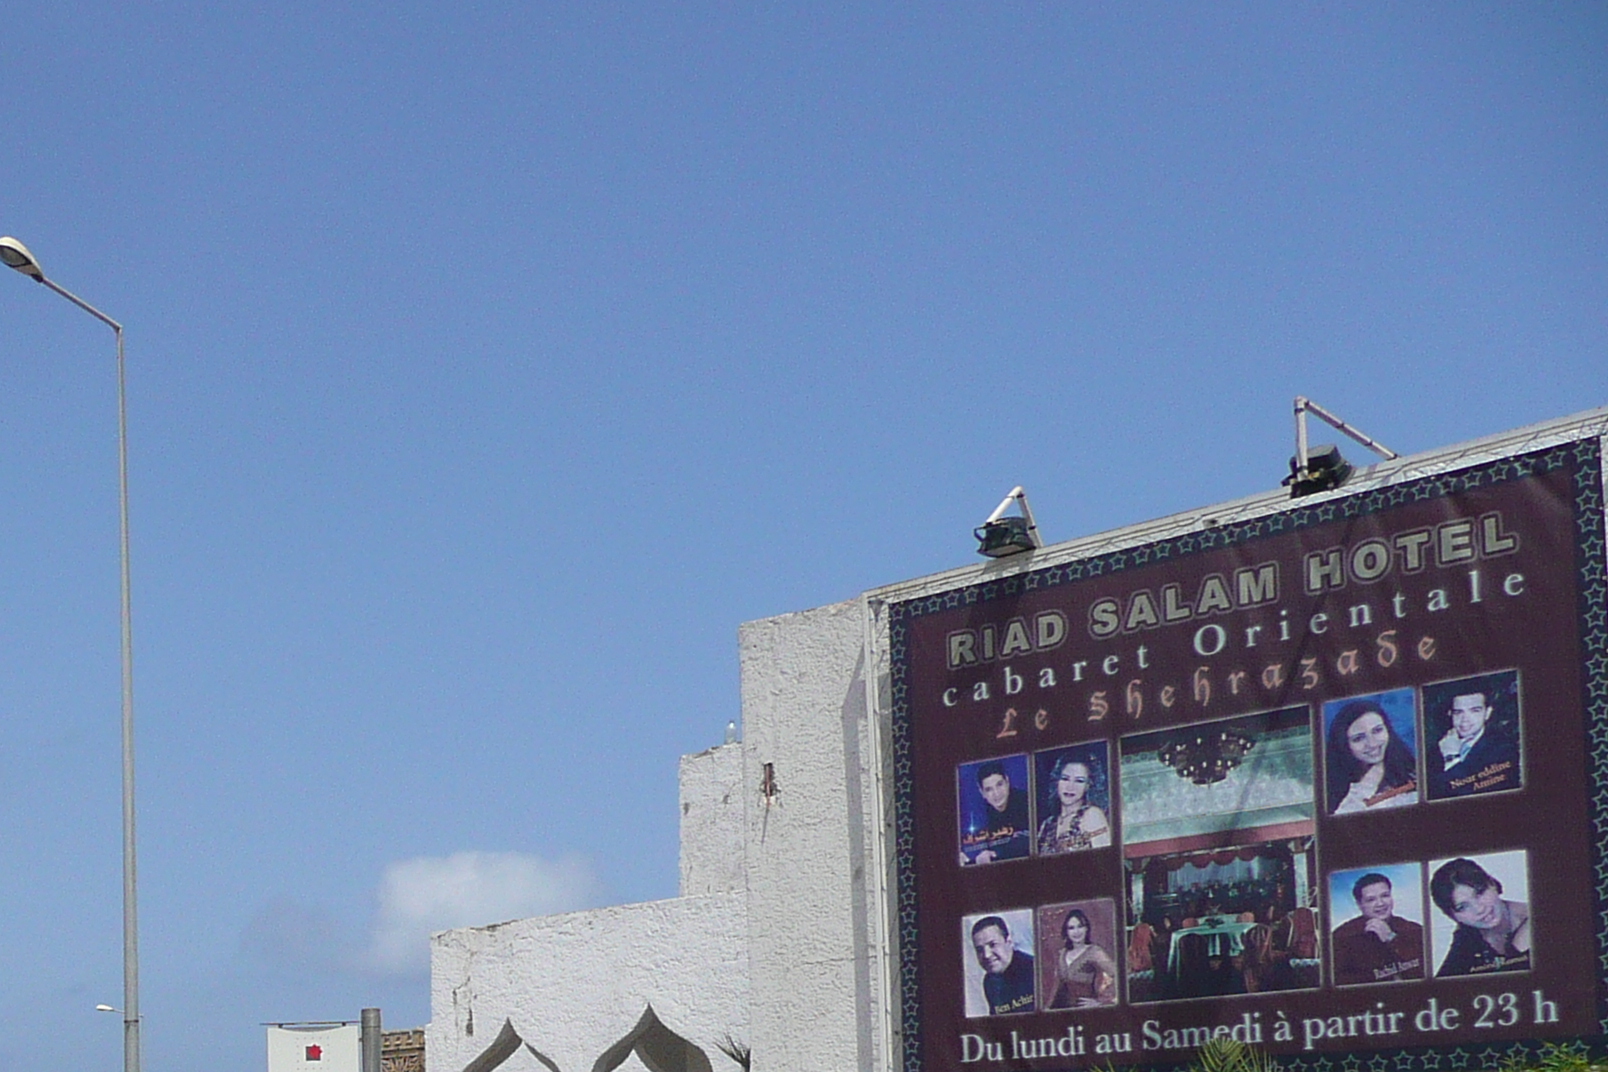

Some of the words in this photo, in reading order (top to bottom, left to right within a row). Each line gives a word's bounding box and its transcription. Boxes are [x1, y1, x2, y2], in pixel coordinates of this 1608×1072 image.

[943, 645, 1149, 706] cabaret
[1194, 570, 1524, 655] Orientale
[948, 611, 1066, 667] RIAD
[1089, 562, 1279, 637] SALAM
[1305, 511, 1518, 594] HOTEL
[997, 708, 1048, 739] Le
[960, 1034, 1003, 1063] Du
[1011, 1025, 1086, 1059] lundi
[1095, 1031, 1132, 1054] au
[1142, 1012, 1263, 1050] Samedi
[1274, 1010, 1293, 1042] à
[1302, 1002, 1404, 1050] partir
[1415, 998, 1459, 1031] de
[1473, 992, 1518, 1028] 23
[1532, 990, 1559, 1024] h
